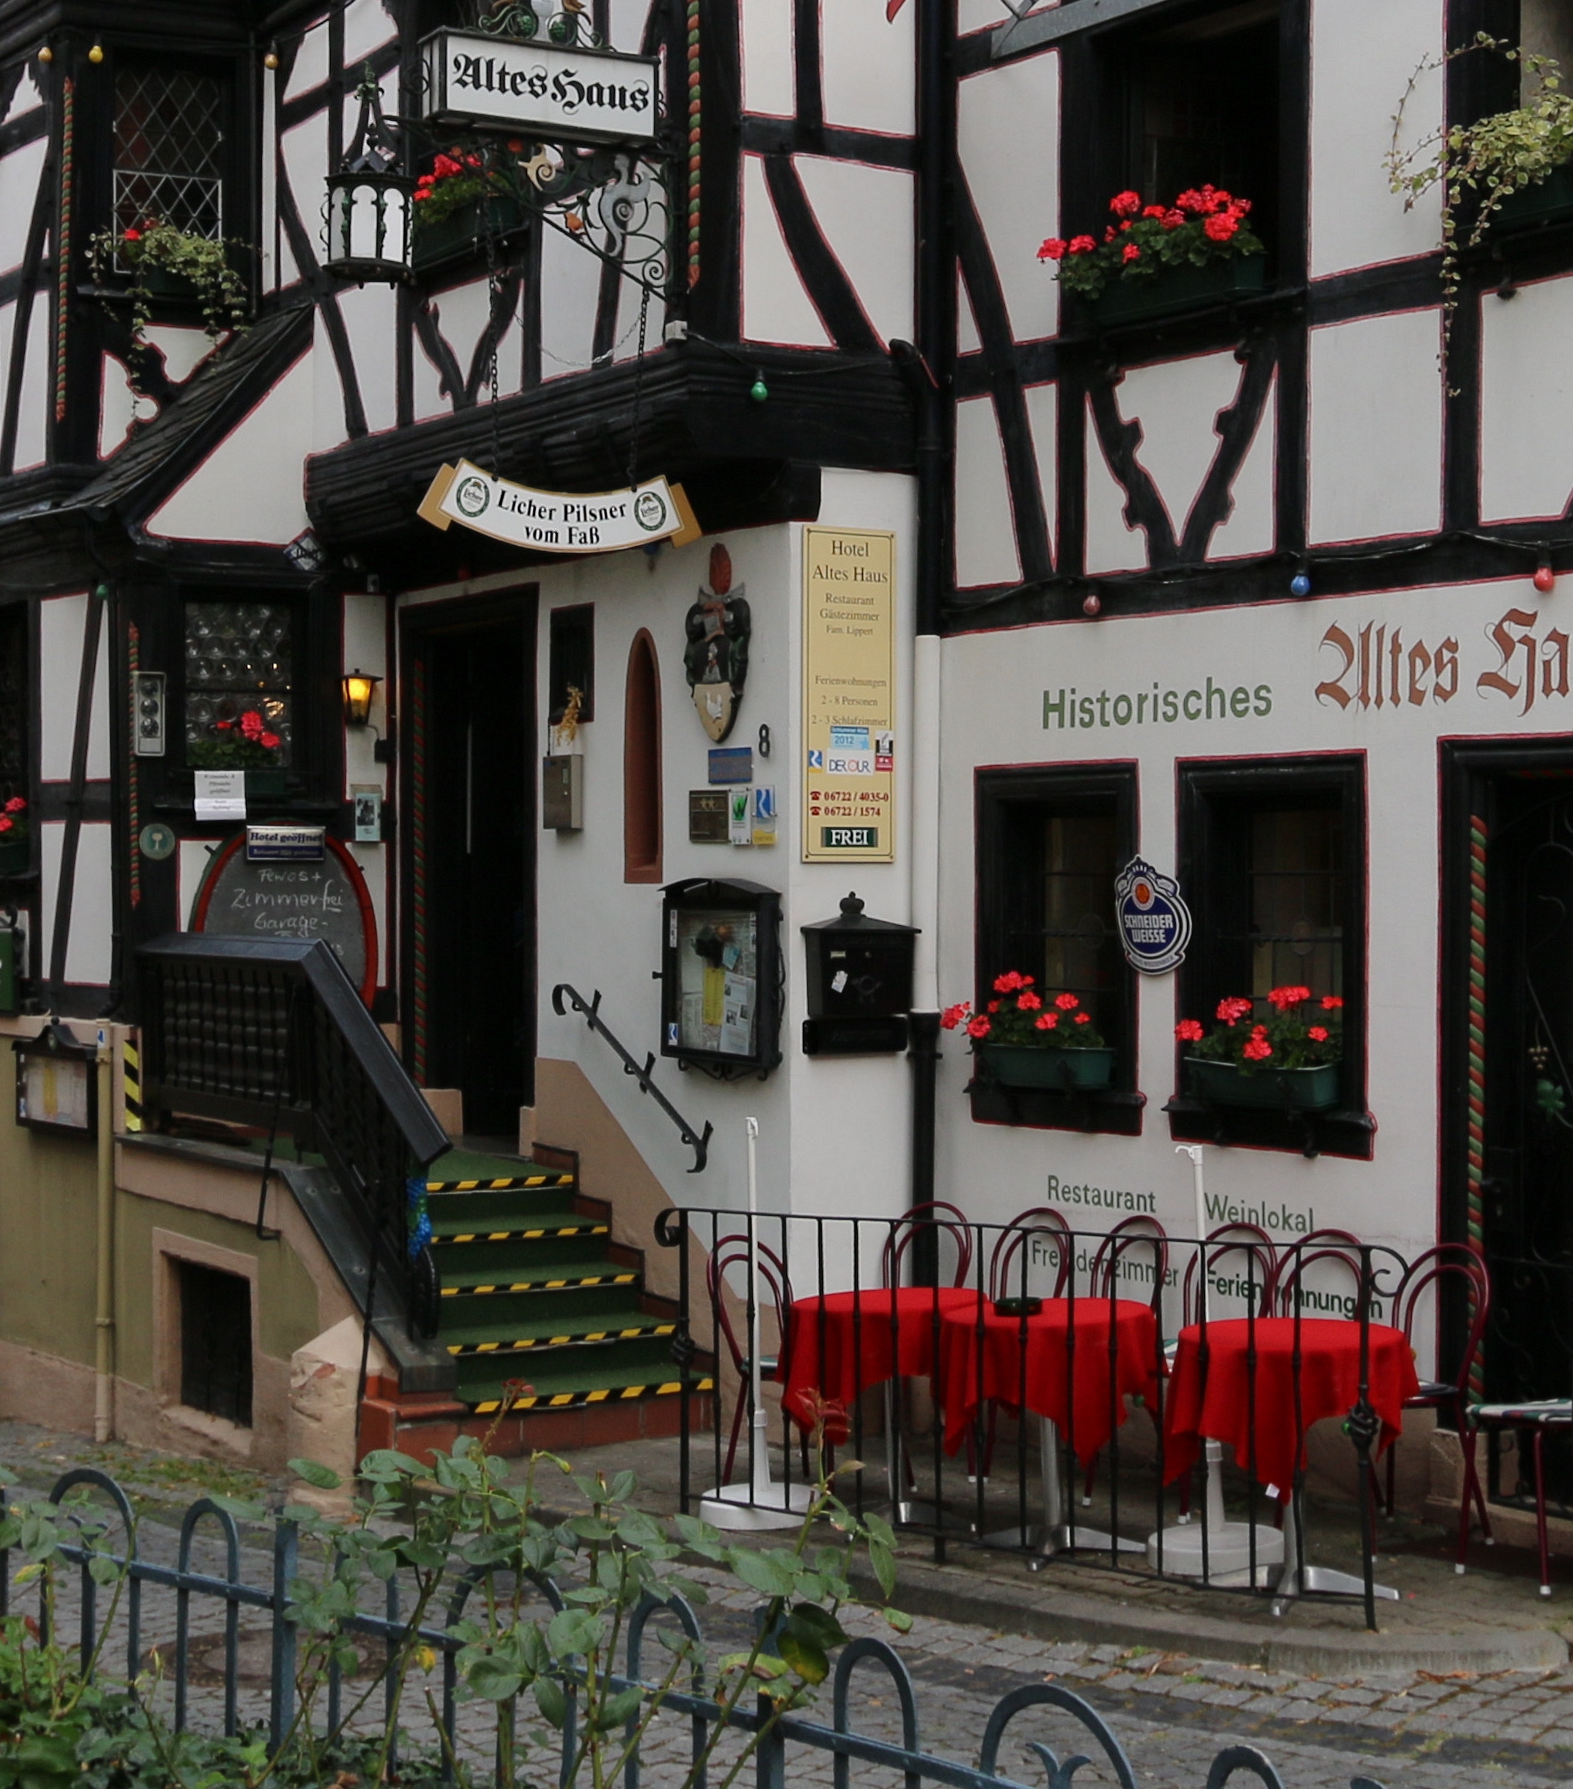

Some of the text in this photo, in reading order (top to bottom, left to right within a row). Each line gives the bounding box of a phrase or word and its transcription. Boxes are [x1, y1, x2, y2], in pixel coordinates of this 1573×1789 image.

[452, 53, 649, 115] Altes Haus
[497, 489, 627, 523] Licher Pilsner
[524, 526, 600, 545] vom Faß
[831, 540, 869, 557] Hotel
[812, 564, 888, 583] Altes Haus
[825, 592, 874, 605] Restaurant
[820, 608, 879, 621] Gästezimmer
[1314, 619, 1460, 712] Altes
[815, 675, 887, 689] Ferienwohnungen
[841, 696, 878, 707] Personen
[1042, 677, 1273, 730] Historisches
[832, 716, 887, 726] Schlafzimmer
[759, 723, 770, 758] 8
[834, 735, 854, 745] 2012
[824, 792, 852, 801] 06722
[859, 792, 889, 802] 4035-0
[824, 806, 852, 816] 06722
[860, 807, 880, 816] 1574
[250, 831, 323, 844] Hotel geöffnet
[830, 829, 869, 845] FREI
[1124, 914, 1173, 928] SCHNEIDER
[1131, 929, 1166, 943] WEISSE
[1047, 1175, 1156, 1214] Restaurant
[1204, 1192, 1314, 1234] Weinlokal
